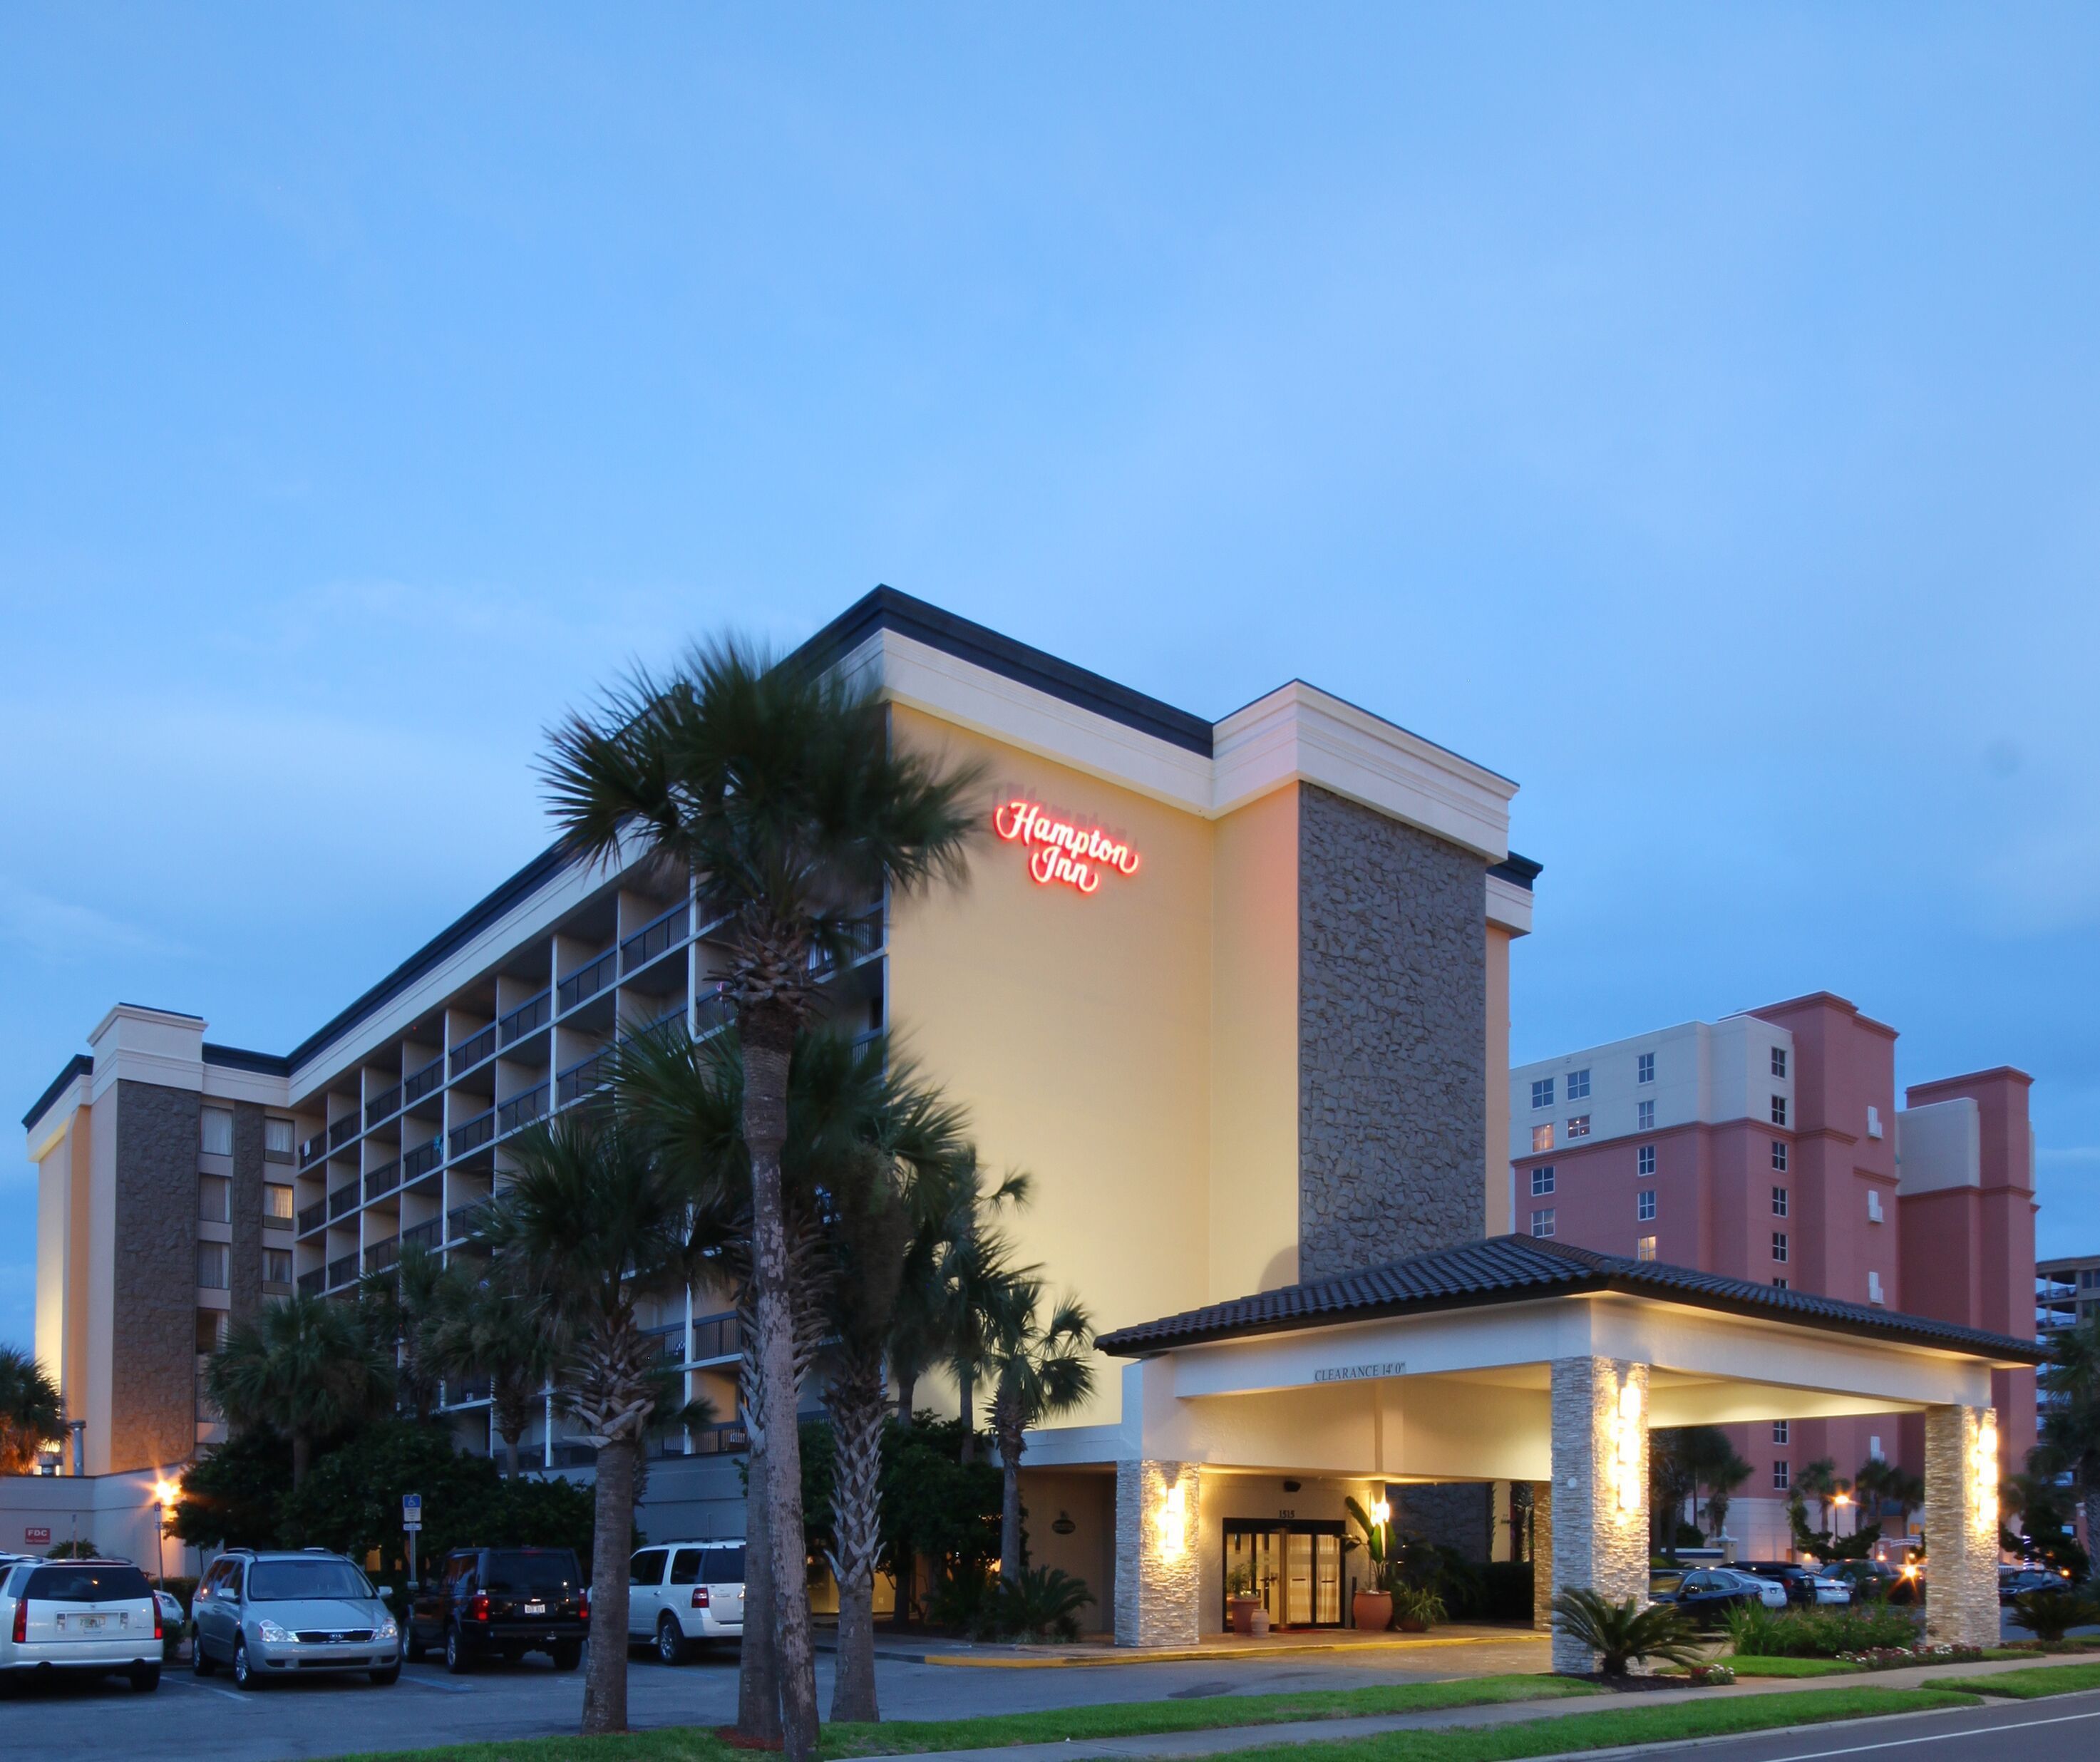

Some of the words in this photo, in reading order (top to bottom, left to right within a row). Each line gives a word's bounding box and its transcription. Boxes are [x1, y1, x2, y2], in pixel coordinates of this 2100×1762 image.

[994, 801, 1140, 875] Hampton
[1029, 845, 1100, 893] Inn
[1314, 1365, 1379, 1381] CLEARANCE
[1279, 1510, 1295, 1518] 1515
